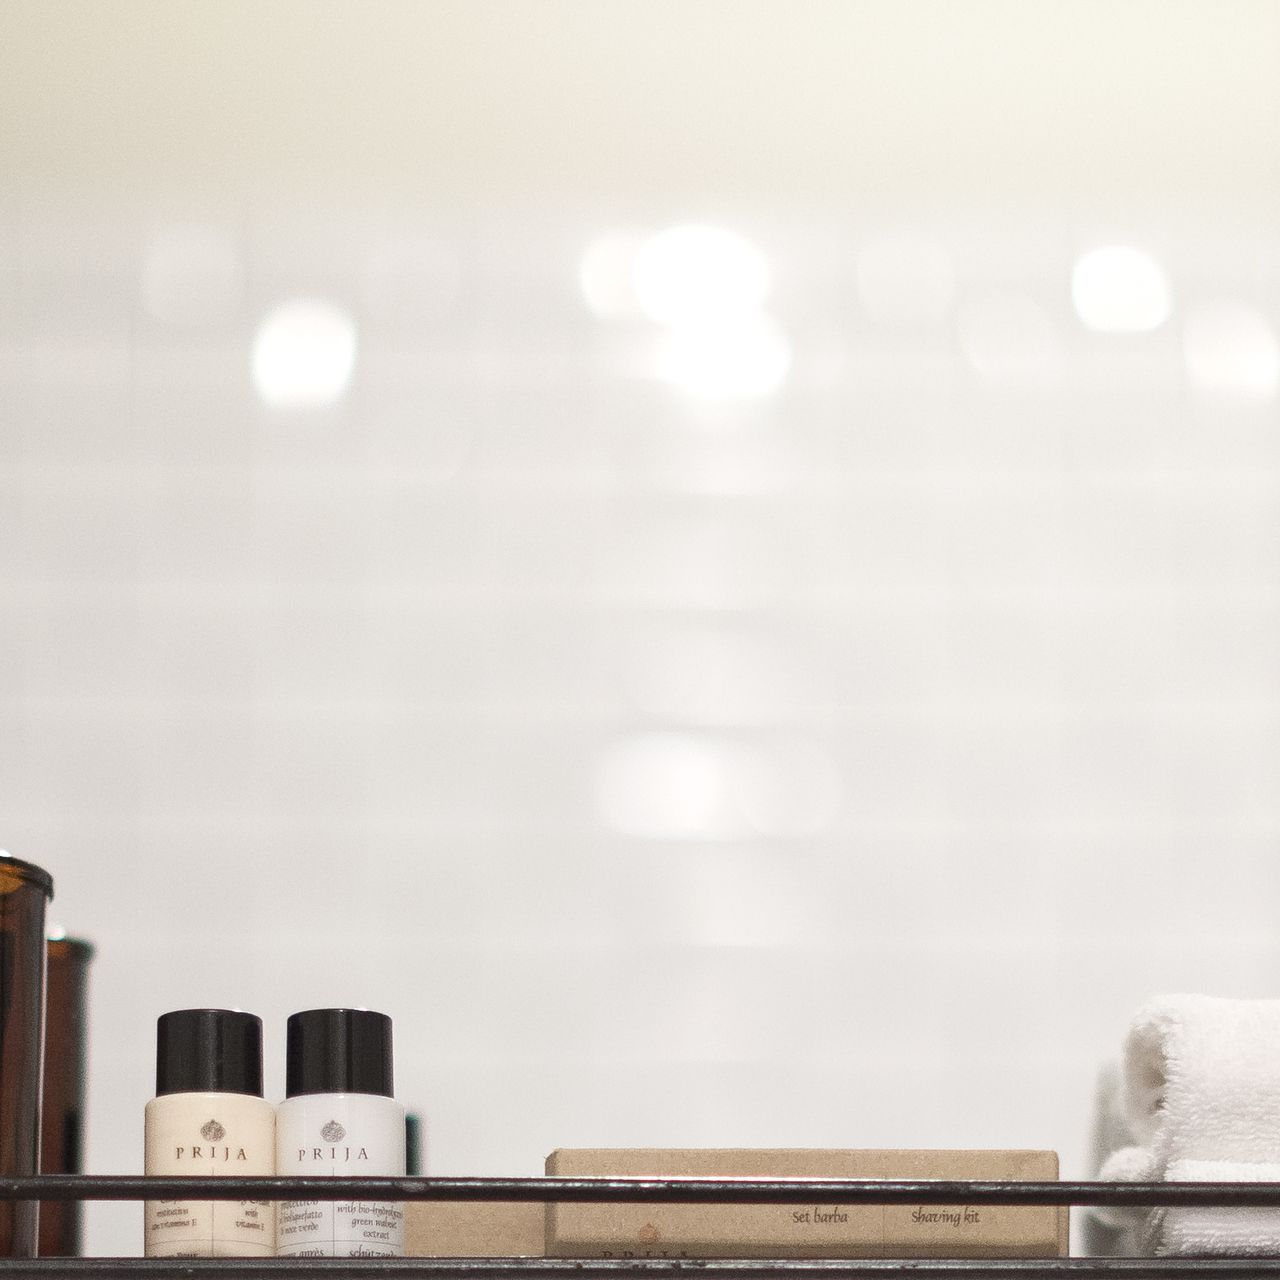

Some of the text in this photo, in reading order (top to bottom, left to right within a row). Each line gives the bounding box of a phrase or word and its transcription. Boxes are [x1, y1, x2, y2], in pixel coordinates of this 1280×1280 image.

[176, 1146, 247, 1161] PRIJA
[298, 1147, 369, 1161] PRIJA
[337, 1200, 357, 1215] with
[792, 1206, 848, 1224] Set barba
[351, 1218, 374, 1229] green
[911, 1206, 981, 1228] Shaving kit
[363, 1230, 390, 1241] extract
